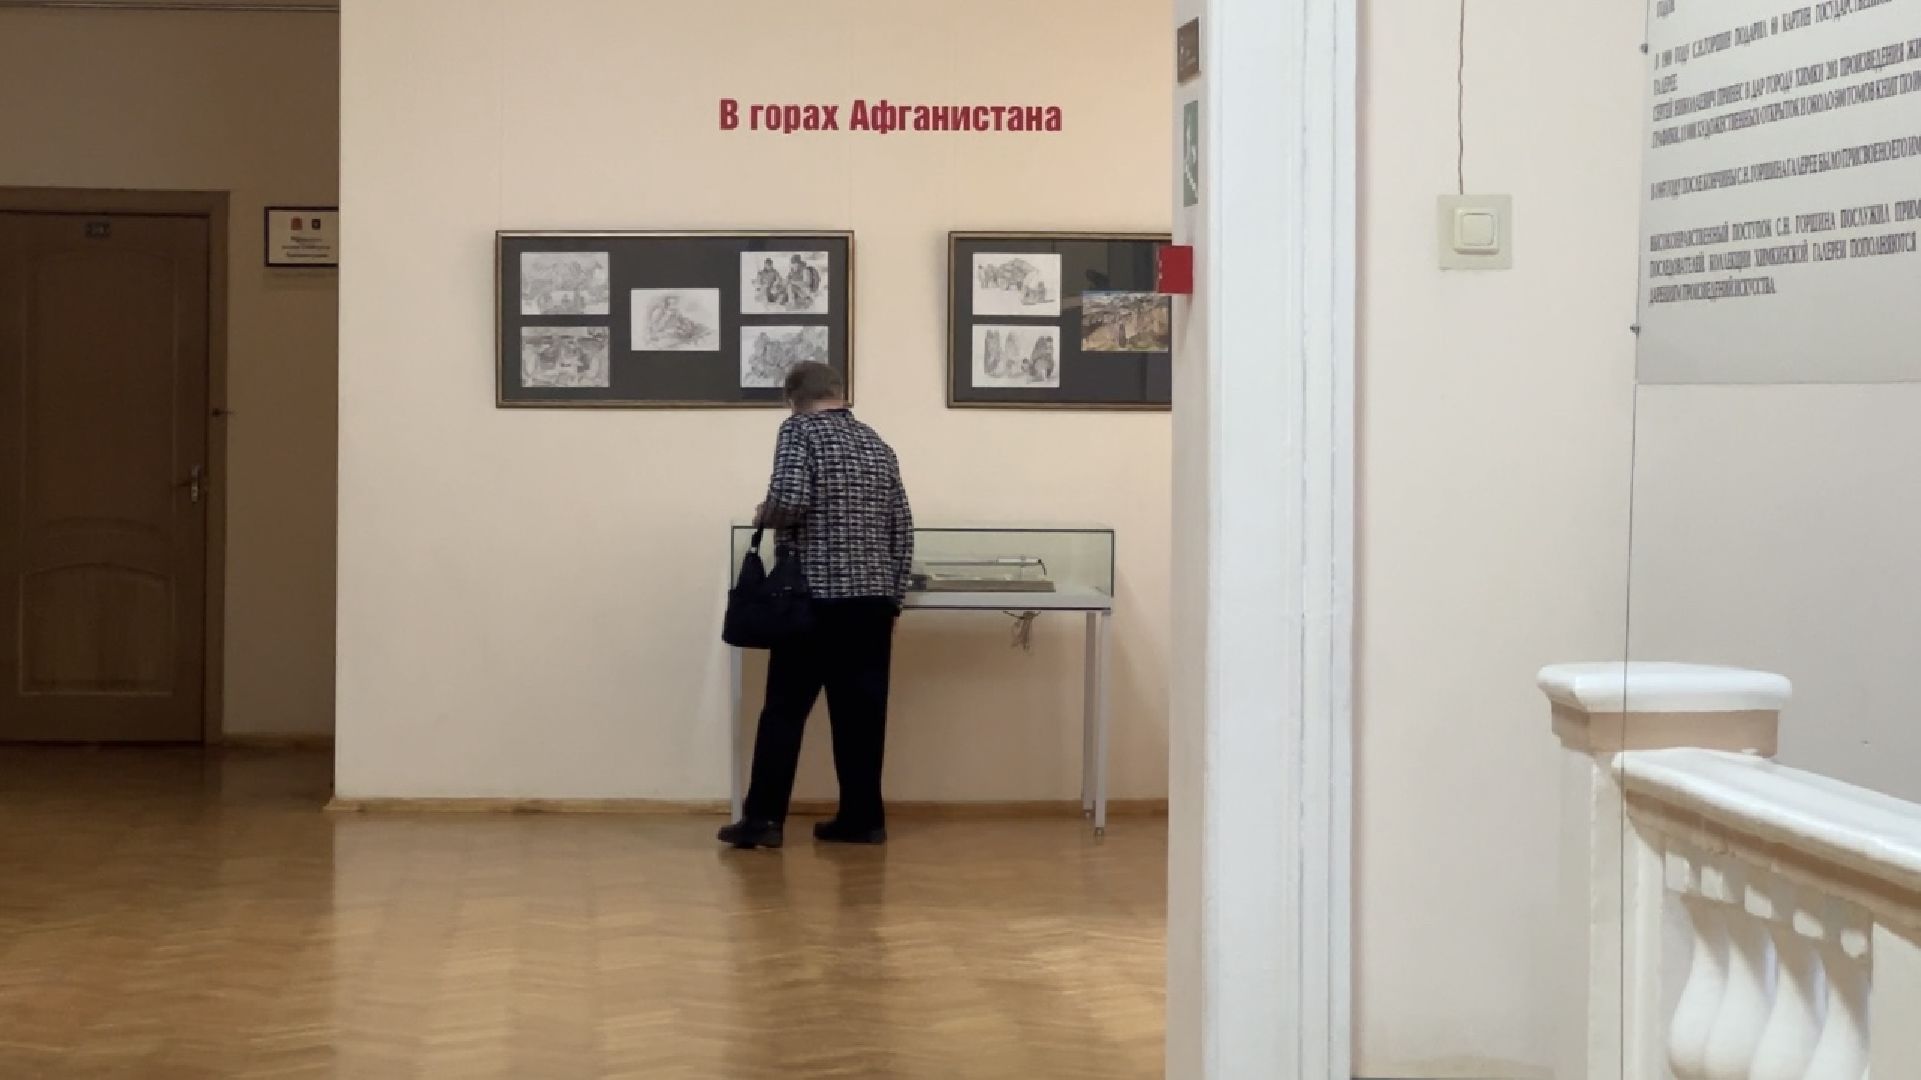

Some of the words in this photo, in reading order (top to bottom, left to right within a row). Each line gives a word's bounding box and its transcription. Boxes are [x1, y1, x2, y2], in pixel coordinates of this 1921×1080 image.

[719, 98, 739, 130] В
[750, 104, 840, 134] горах
[849, 99, 1063, 134] Афганистана
